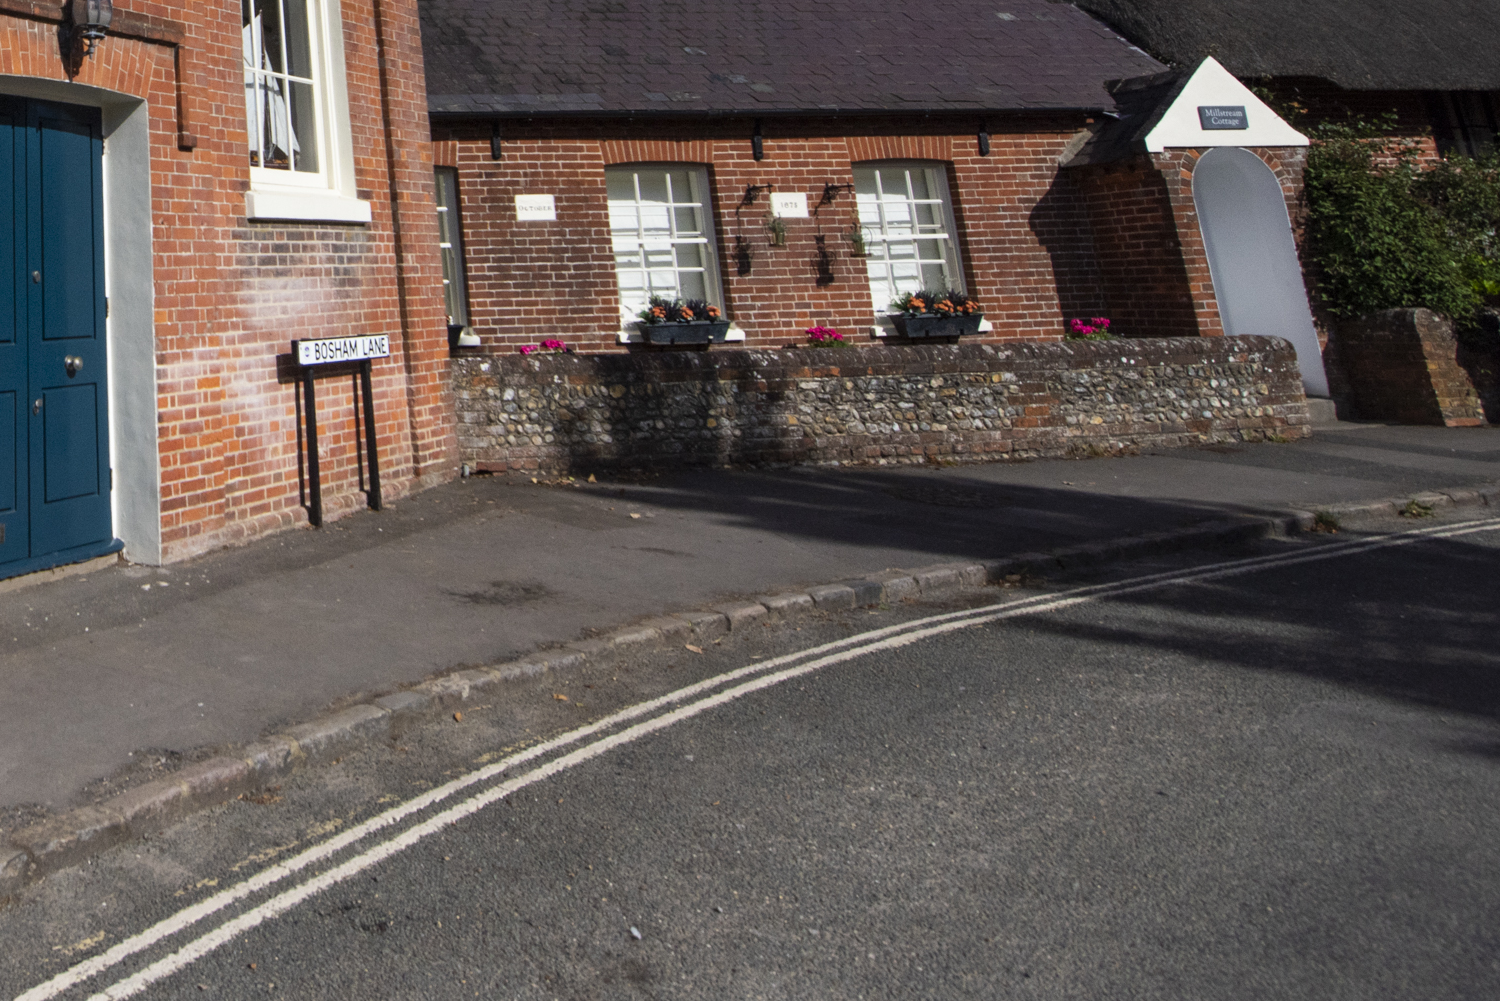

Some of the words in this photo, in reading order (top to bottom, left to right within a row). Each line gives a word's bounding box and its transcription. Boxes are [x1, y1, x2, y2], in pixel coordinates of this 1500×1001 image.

[1205, 108, 1243, 117] Millstream
[1211, 116, 1240, 126] Cottage
[314, 340, 358, 360] BOSHAM
[362, 337, 387, 356] LANE
